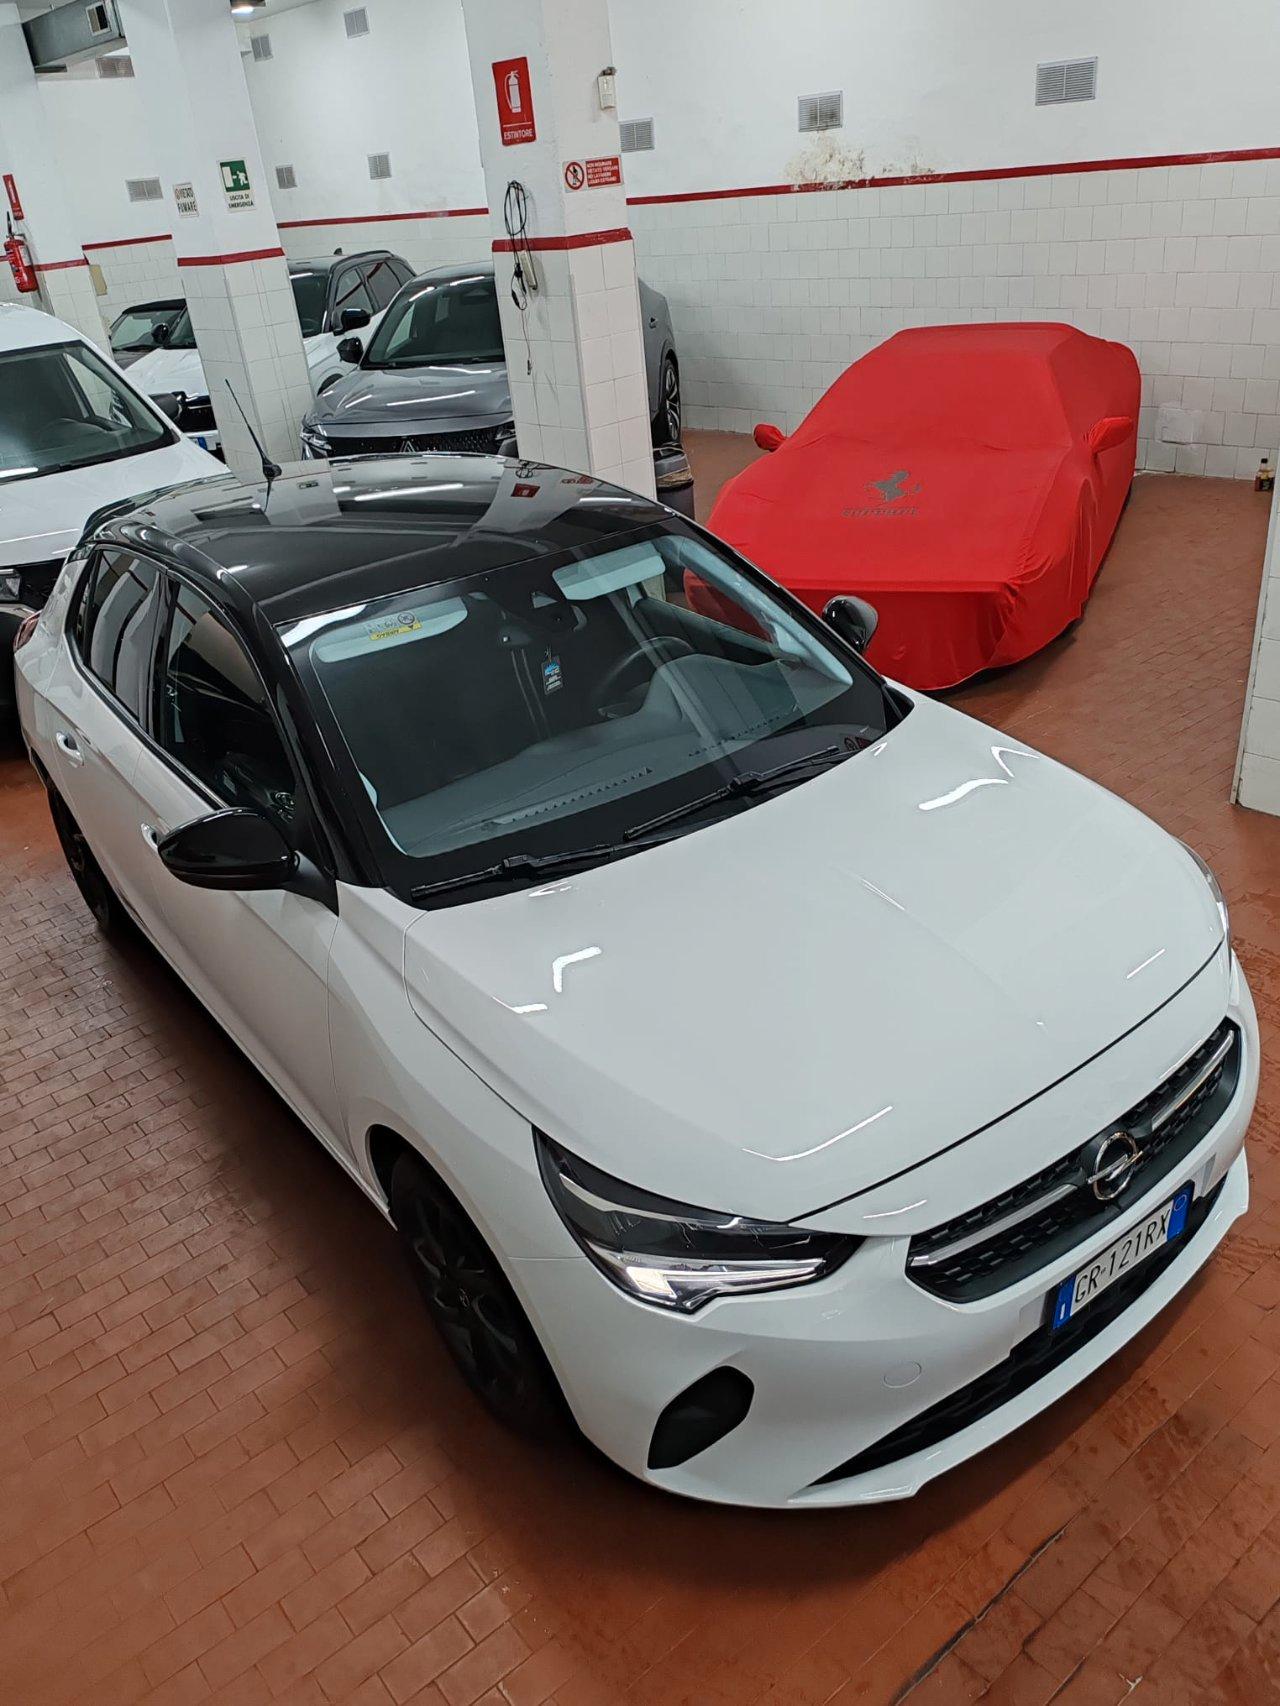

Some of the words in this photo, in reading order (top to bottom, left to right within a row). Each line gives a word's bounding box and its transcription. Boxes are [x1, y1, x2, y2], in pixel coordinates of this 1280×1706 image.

[503, 129, 533, 140] ESTINTORE
[177, 201, 197, 213] FUMARE
[228, 200, 254, 209] EMERGENZA
